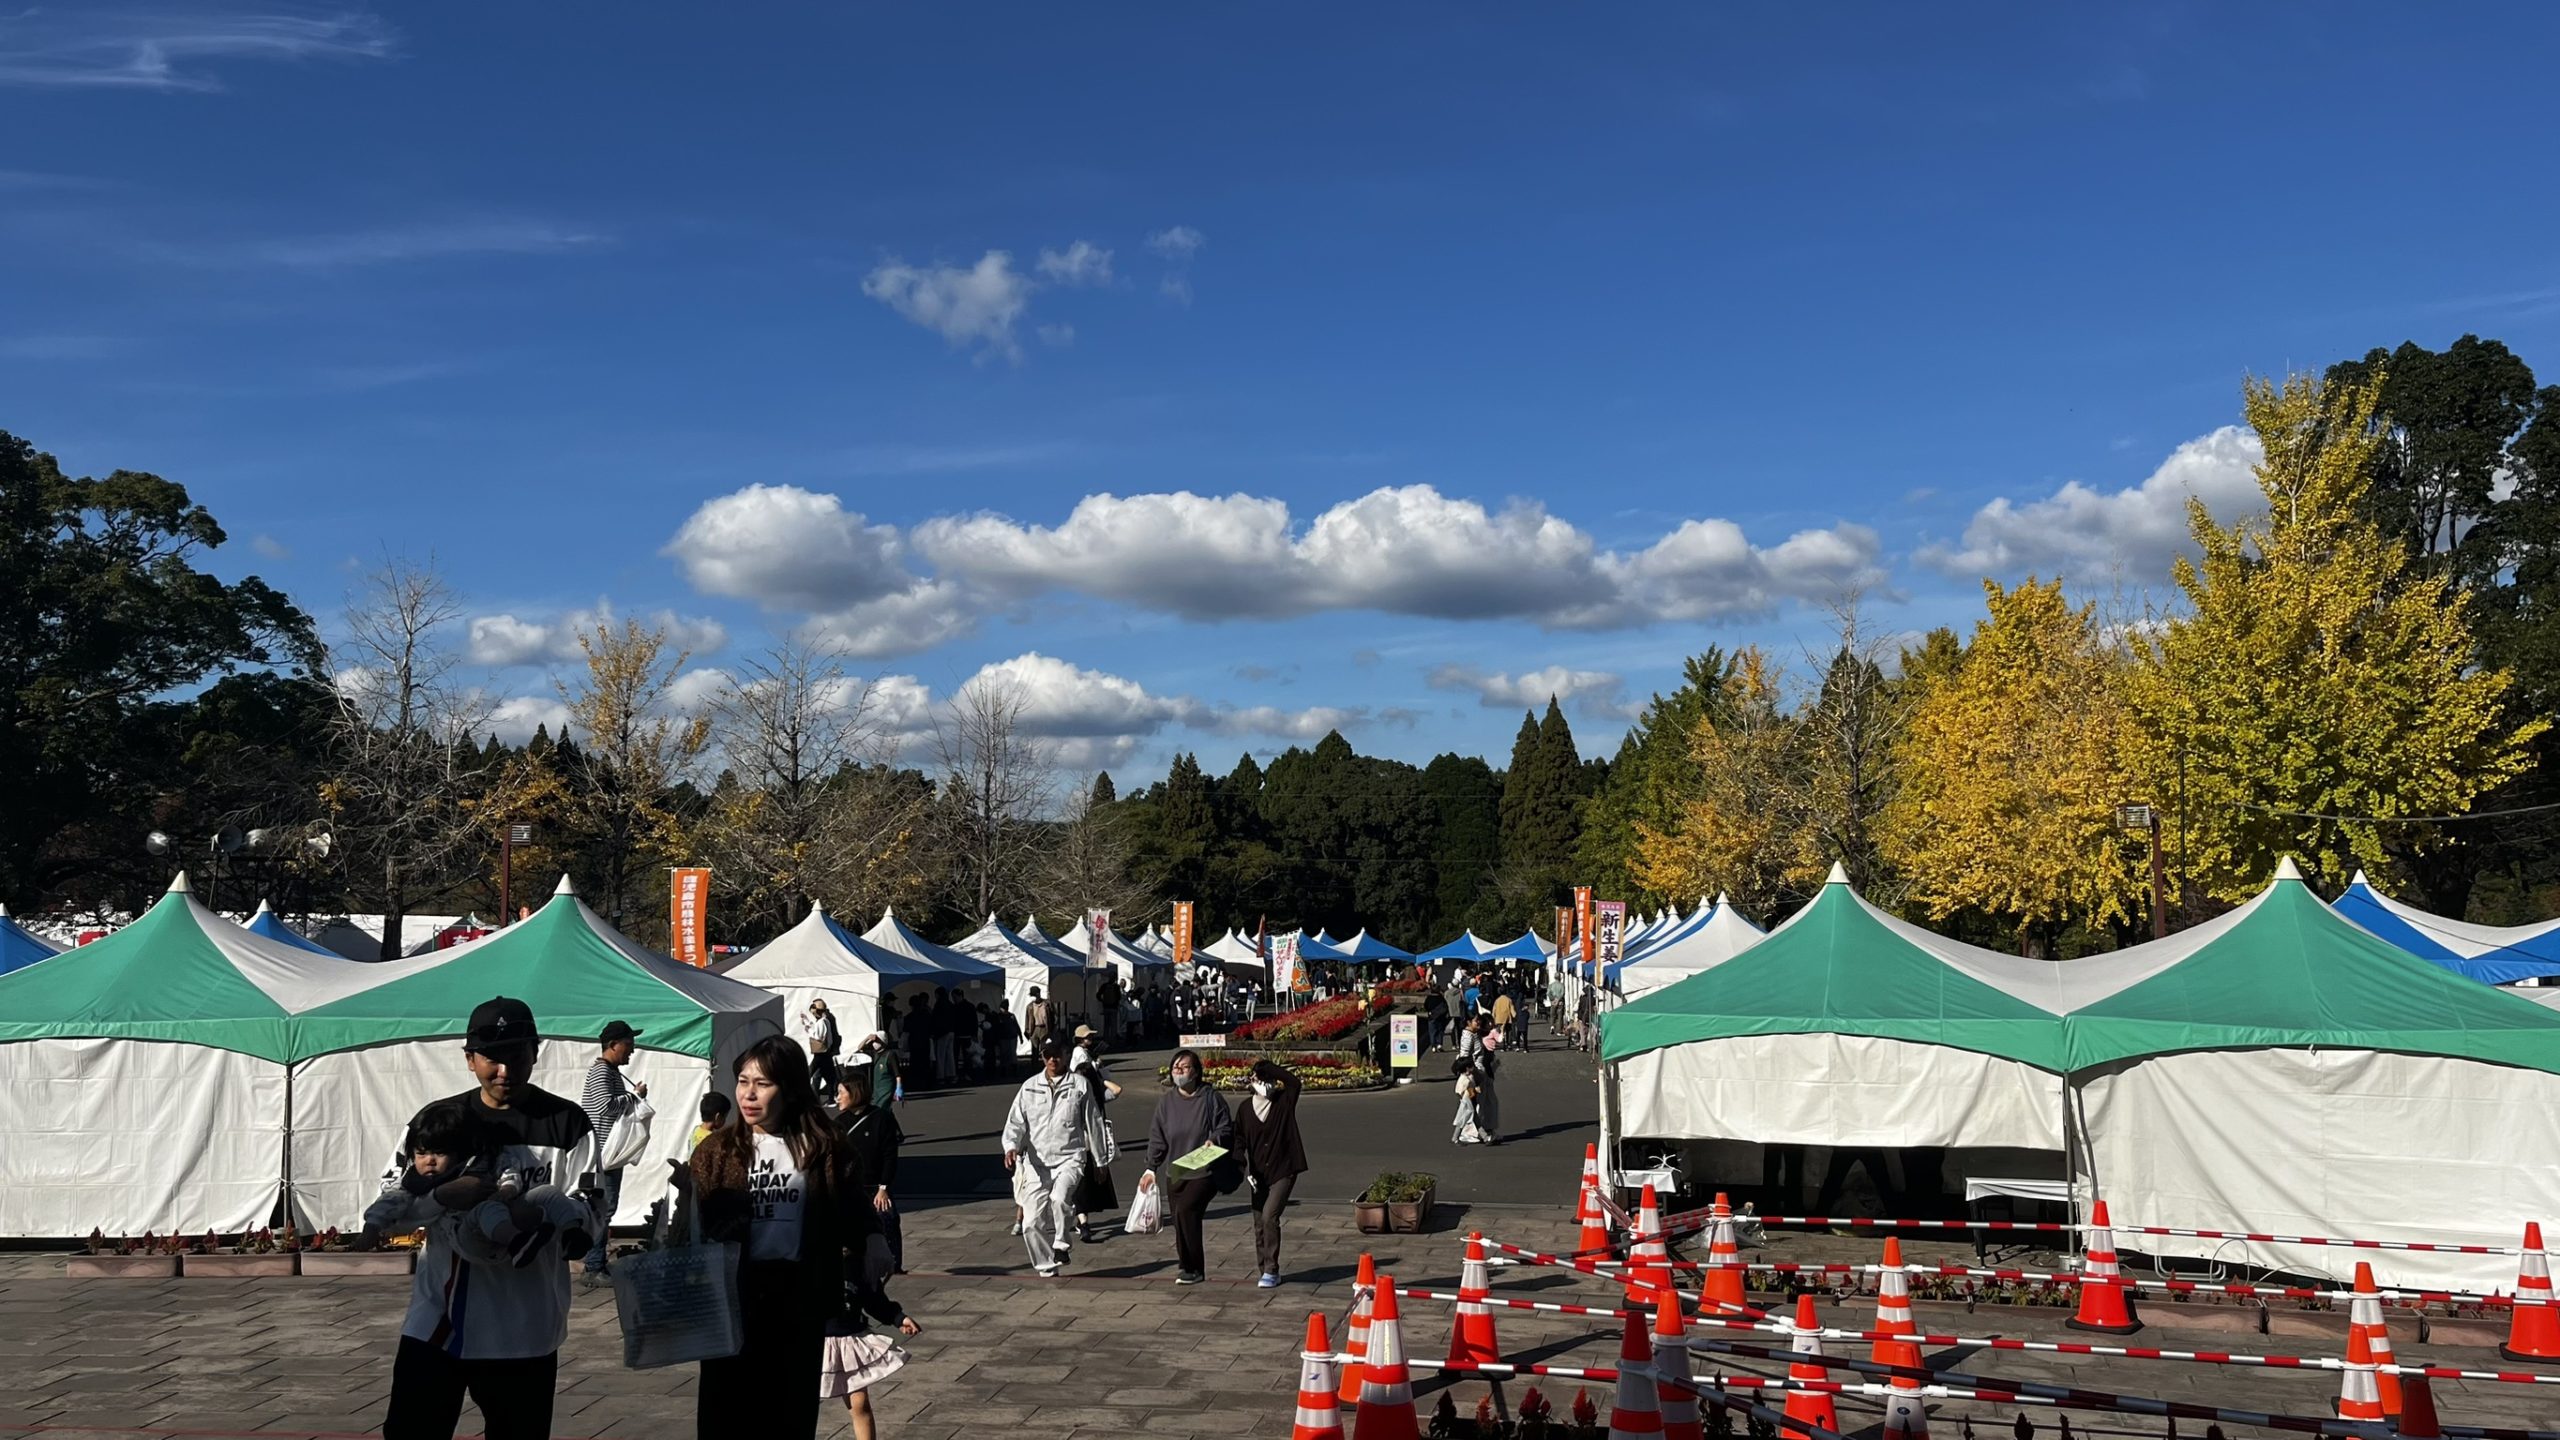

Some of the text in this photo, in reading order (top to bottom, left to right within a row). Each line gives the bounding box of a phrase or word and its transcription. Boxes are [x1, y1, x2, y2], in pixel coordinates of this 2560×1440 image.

[1600, 911, 1620, 963] 新生姜
[750, 1159, 775, 1175] LM
[748, 1173, 792, 1190] NDAY
[751, 1187, 800, 1205] RNING
[754, 1203, 776, 1220] LE
